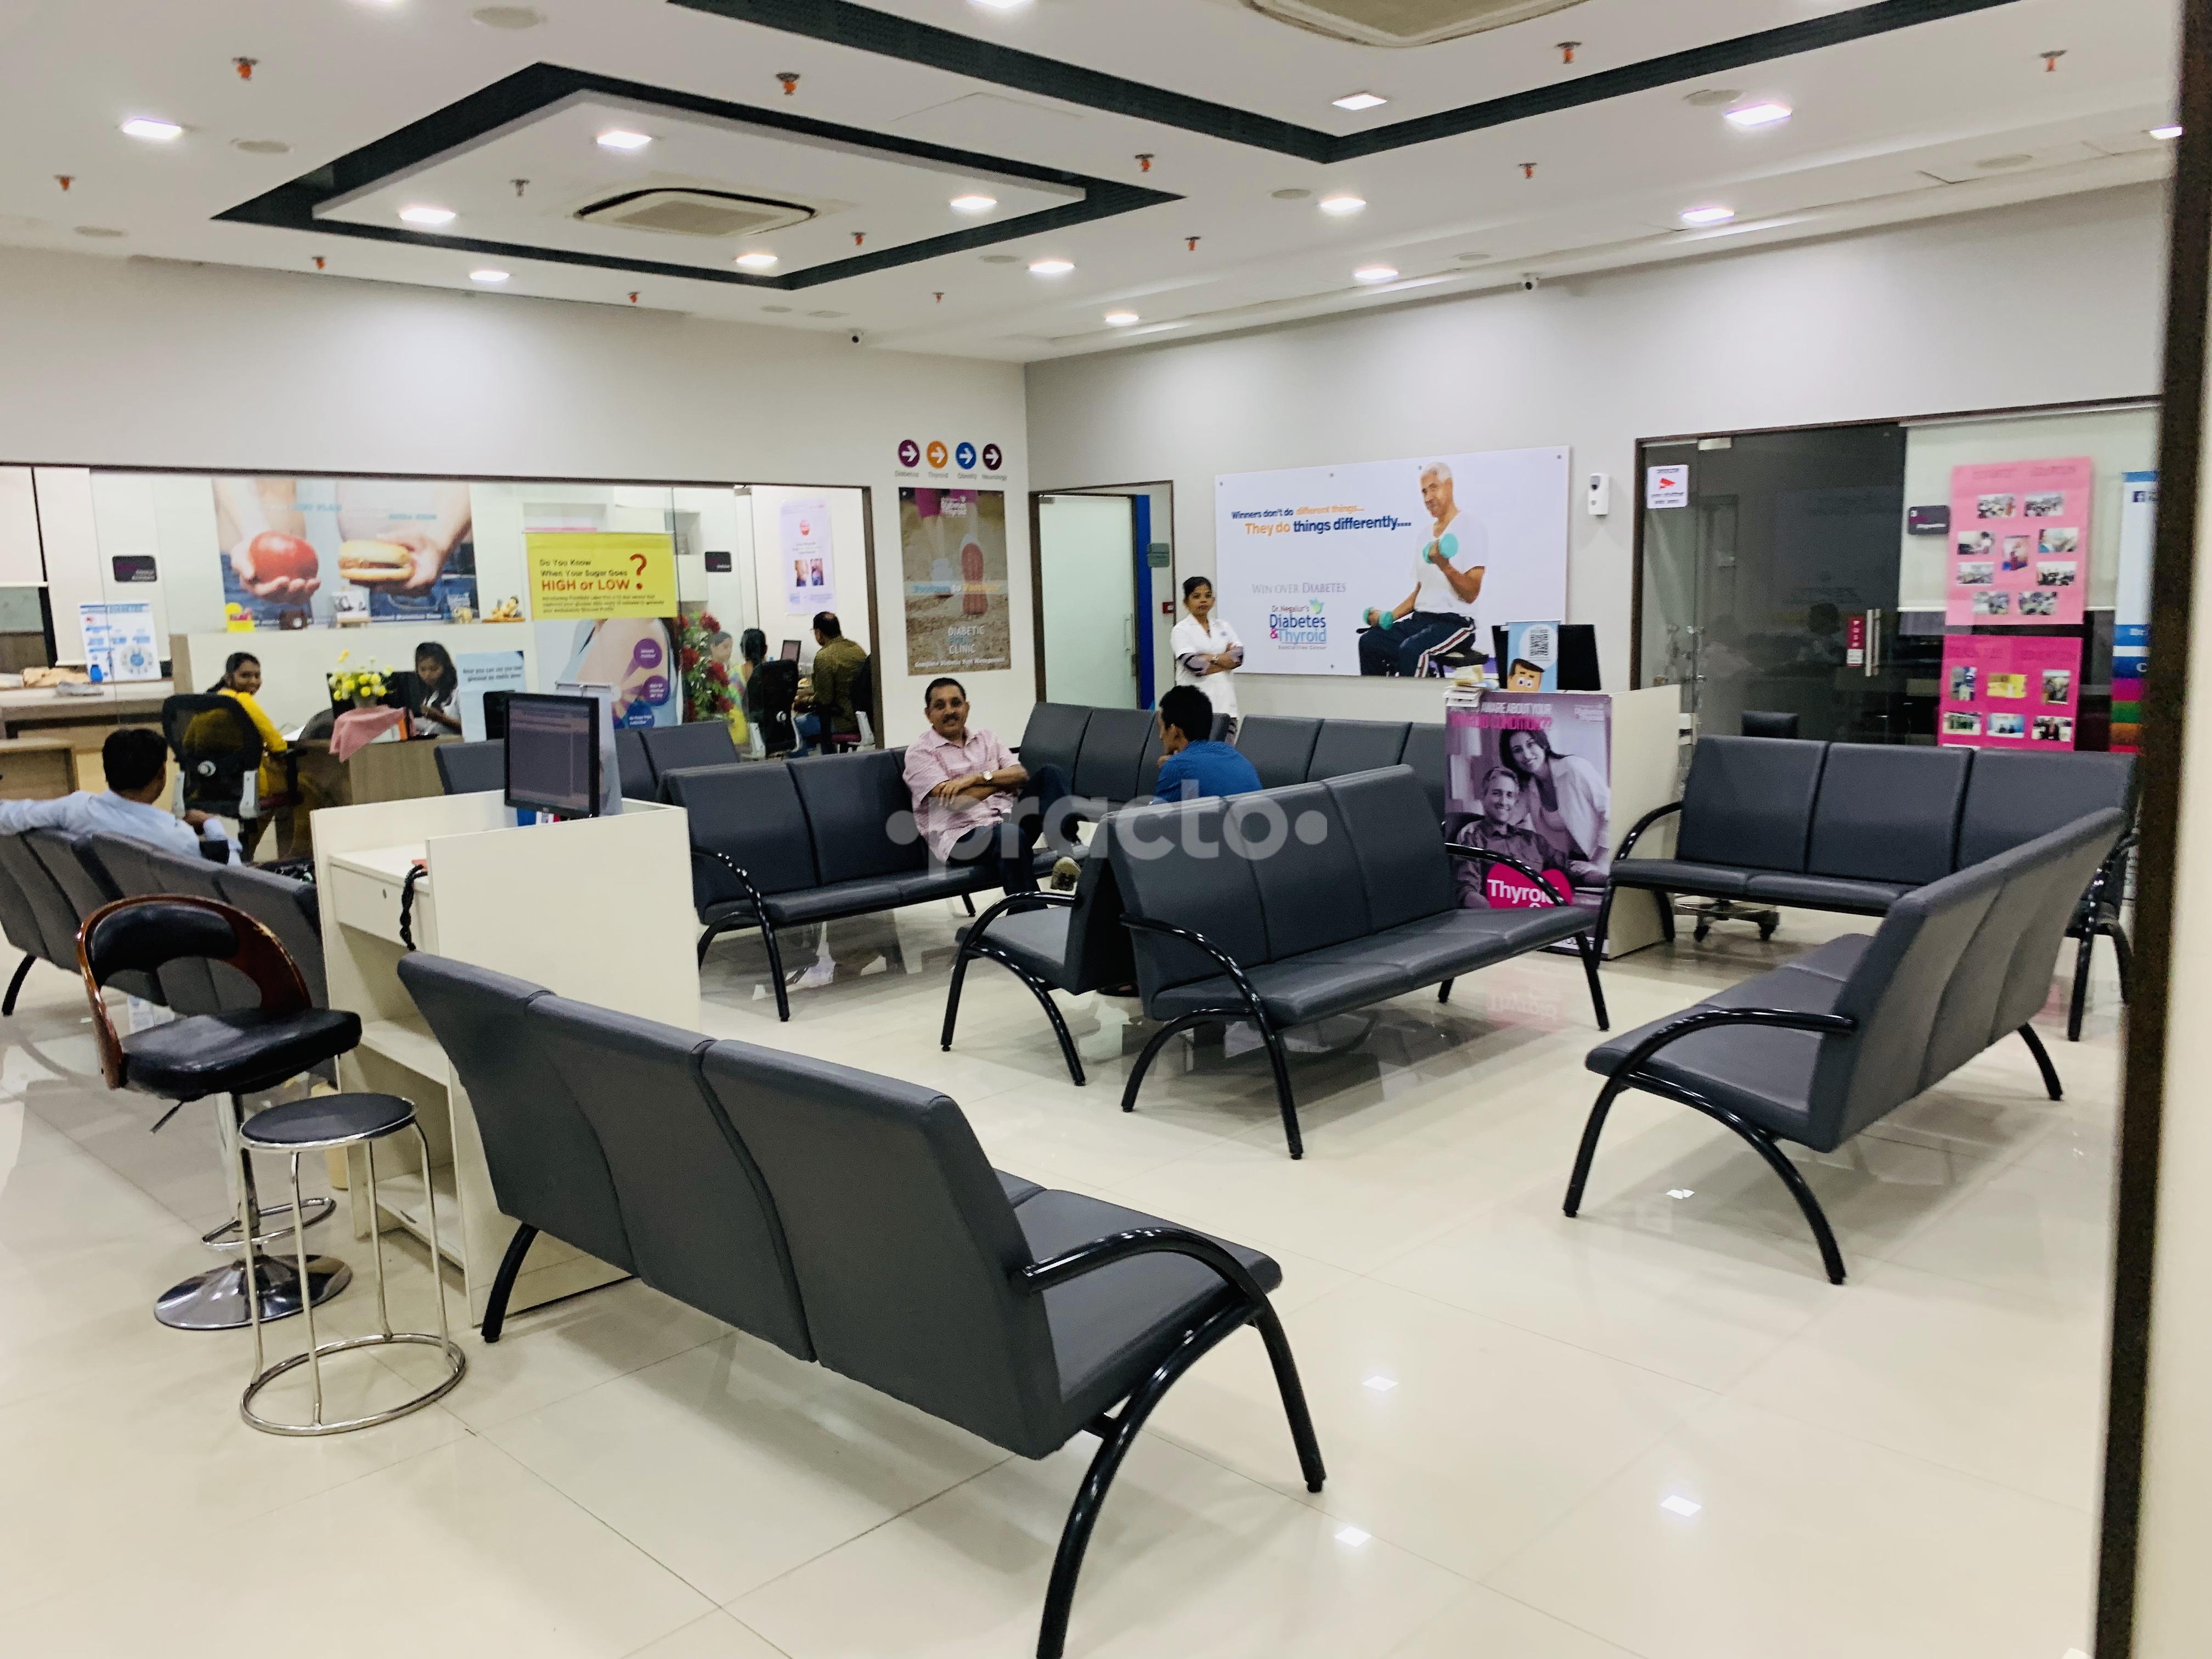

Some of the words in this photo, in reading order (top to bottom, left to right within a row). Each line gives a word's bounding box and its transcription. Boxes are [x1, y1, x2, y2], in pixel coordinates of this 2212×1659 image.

[1231, 511, 1262, 519] Winners
[1263, 509, 1283, 517] don't
[1284, 508, 1294, 516] do
[1296, 507, 1329, 516] different
[1245, 522, 1274, 537] They
[1276, 521, 1290, 533] do
[1293, 520, 1331, 534] things
[541, 579, 576, 591] HIGH
[579, 582, 594, 591] or
[598, 579, 630, 591] LOW
[630, 553, 647, 590] ?
[585, 569, 607, 578] Sugar
[1269, 614, 1326, 628] Diabetes
[947, 625, 985, 636] DIABETIC
[1270, 627, 1278, 639] &
[1278, 628, 1327, 645] Thyroid
[949, 644, 976, 654] CLINIC
[1481, 702, 1508, 713] AWARE
[1507, 702, 1532, 714] ABOUT
[1531, 703, 1553, 714] YOUR
[1487, 879, 1559, 904] Thyroi
